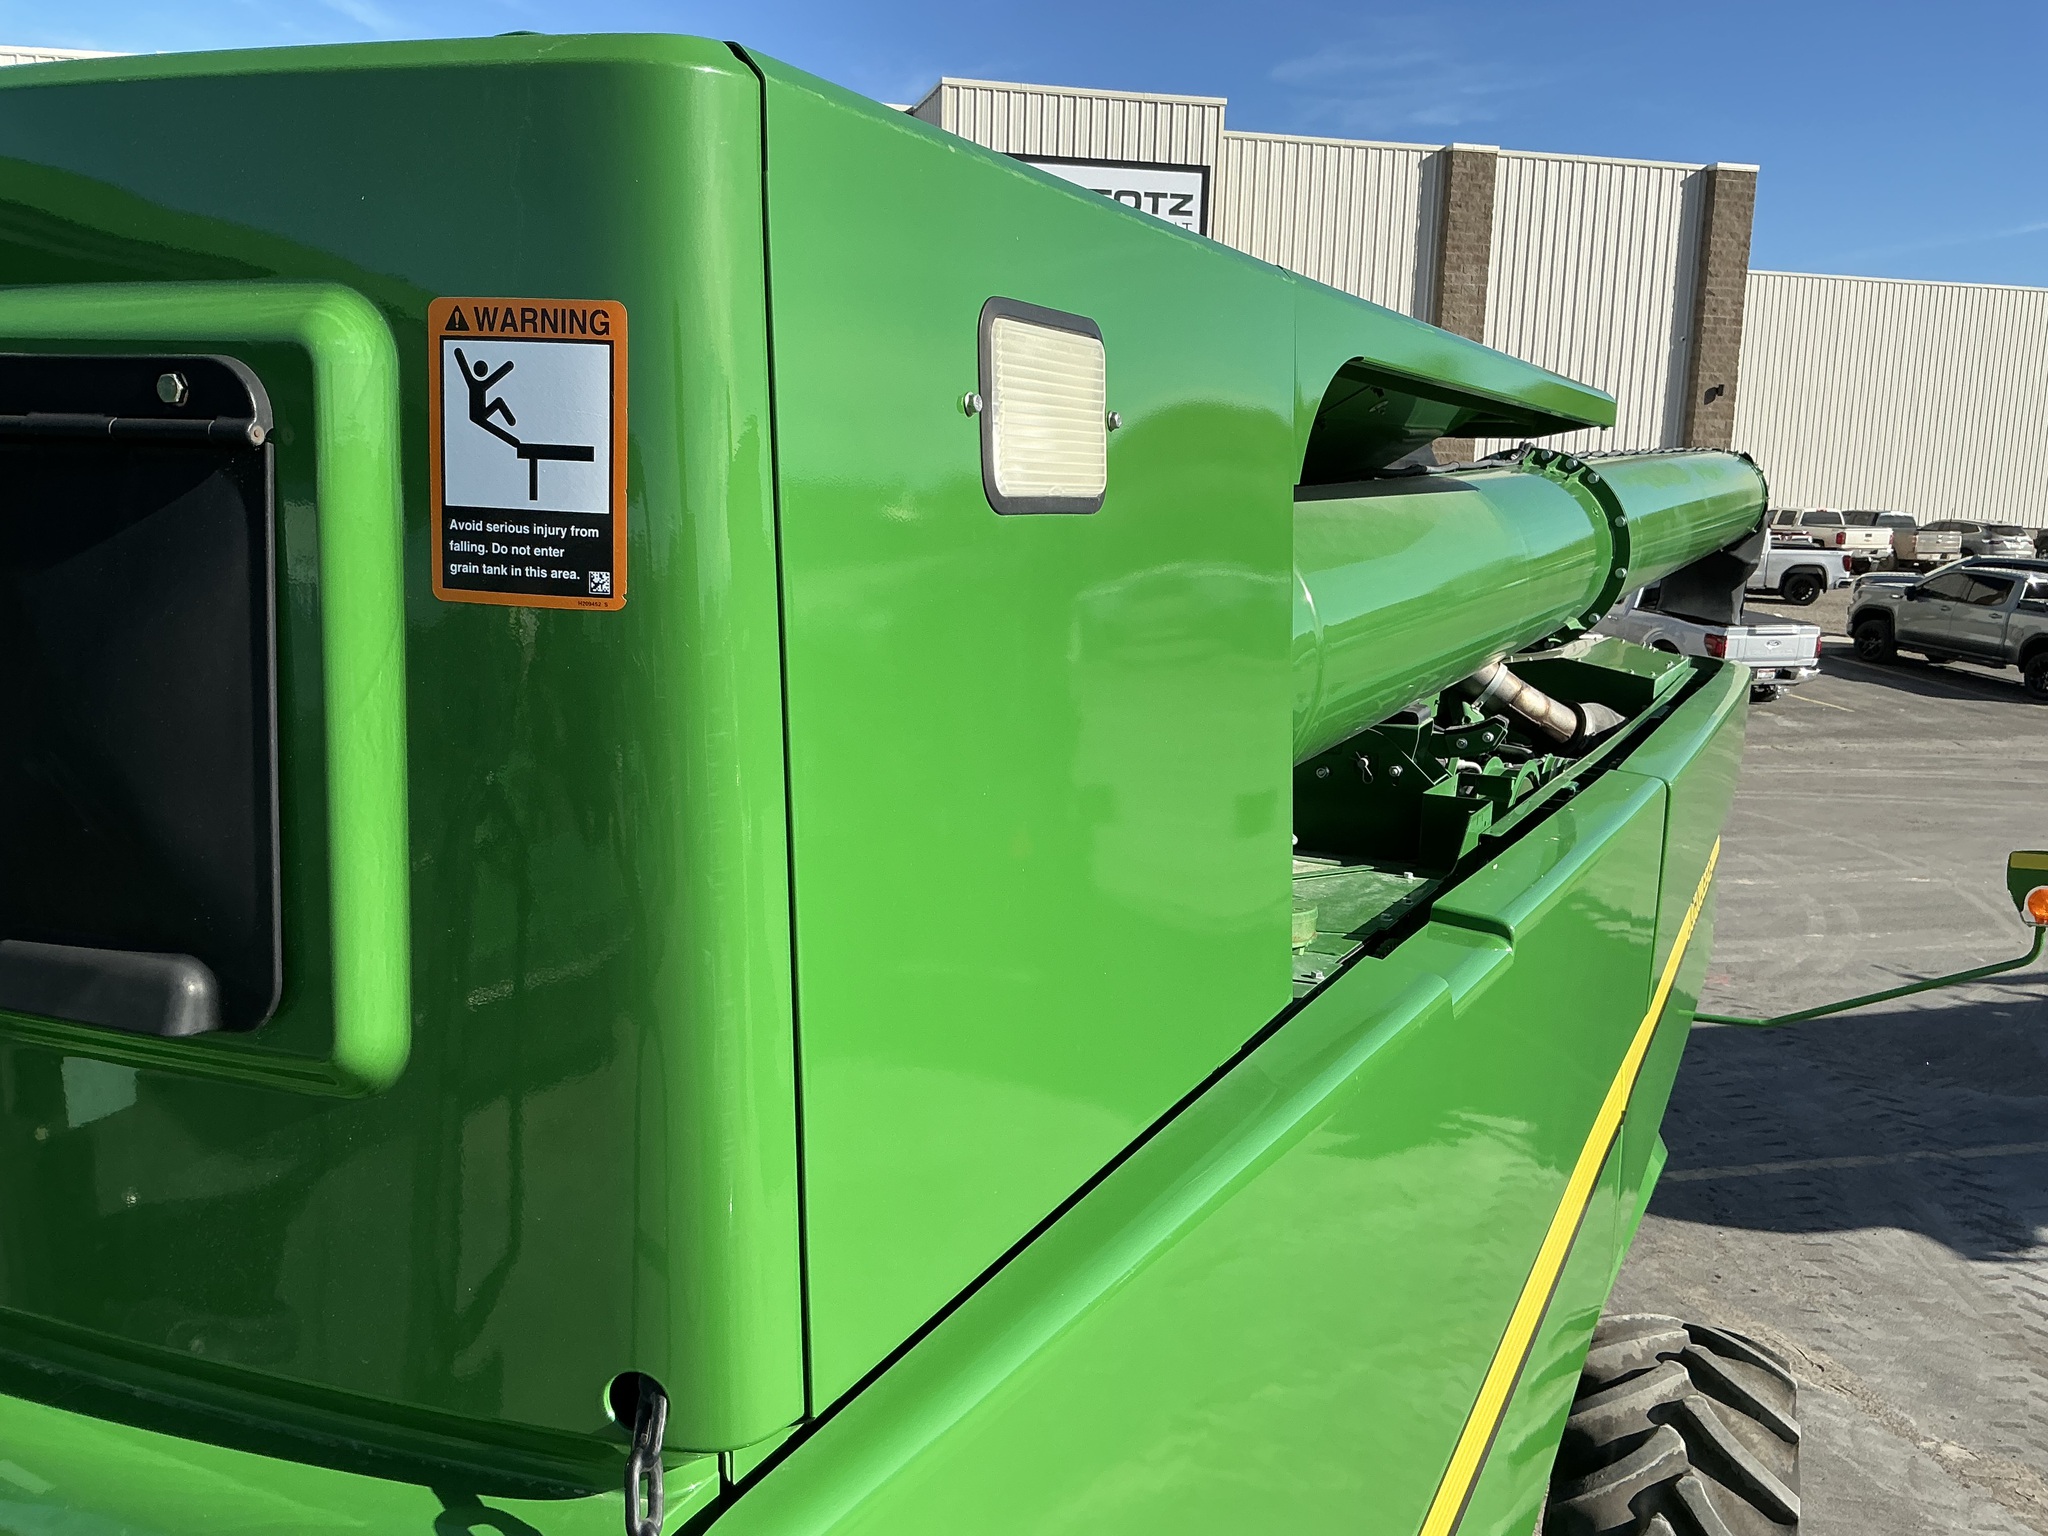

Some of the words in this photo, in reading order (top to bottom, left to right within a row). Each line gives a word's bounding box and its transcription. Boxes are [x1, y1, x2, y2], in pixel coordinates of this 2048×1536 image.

[474, 306, 610, 336] WARNING
[449, 518, 483, 533] Avoid
[486, 521, 530, 535] serious
[533, 523, 567, 539] injury
[570, 525, 600, 538] from
[449, 540, 489, 556] falling.
[491, 542, 508, 555] Do
[511, 545, 531, 556] not
[533, 547, 565, 558] enter
[450, 562, 479, 576] grain
[482, 563, 508, 578] tank
[511, 565, 522, 578] in
[525, 567, 548, 579] this
[550, 570, 581, 582] area.
